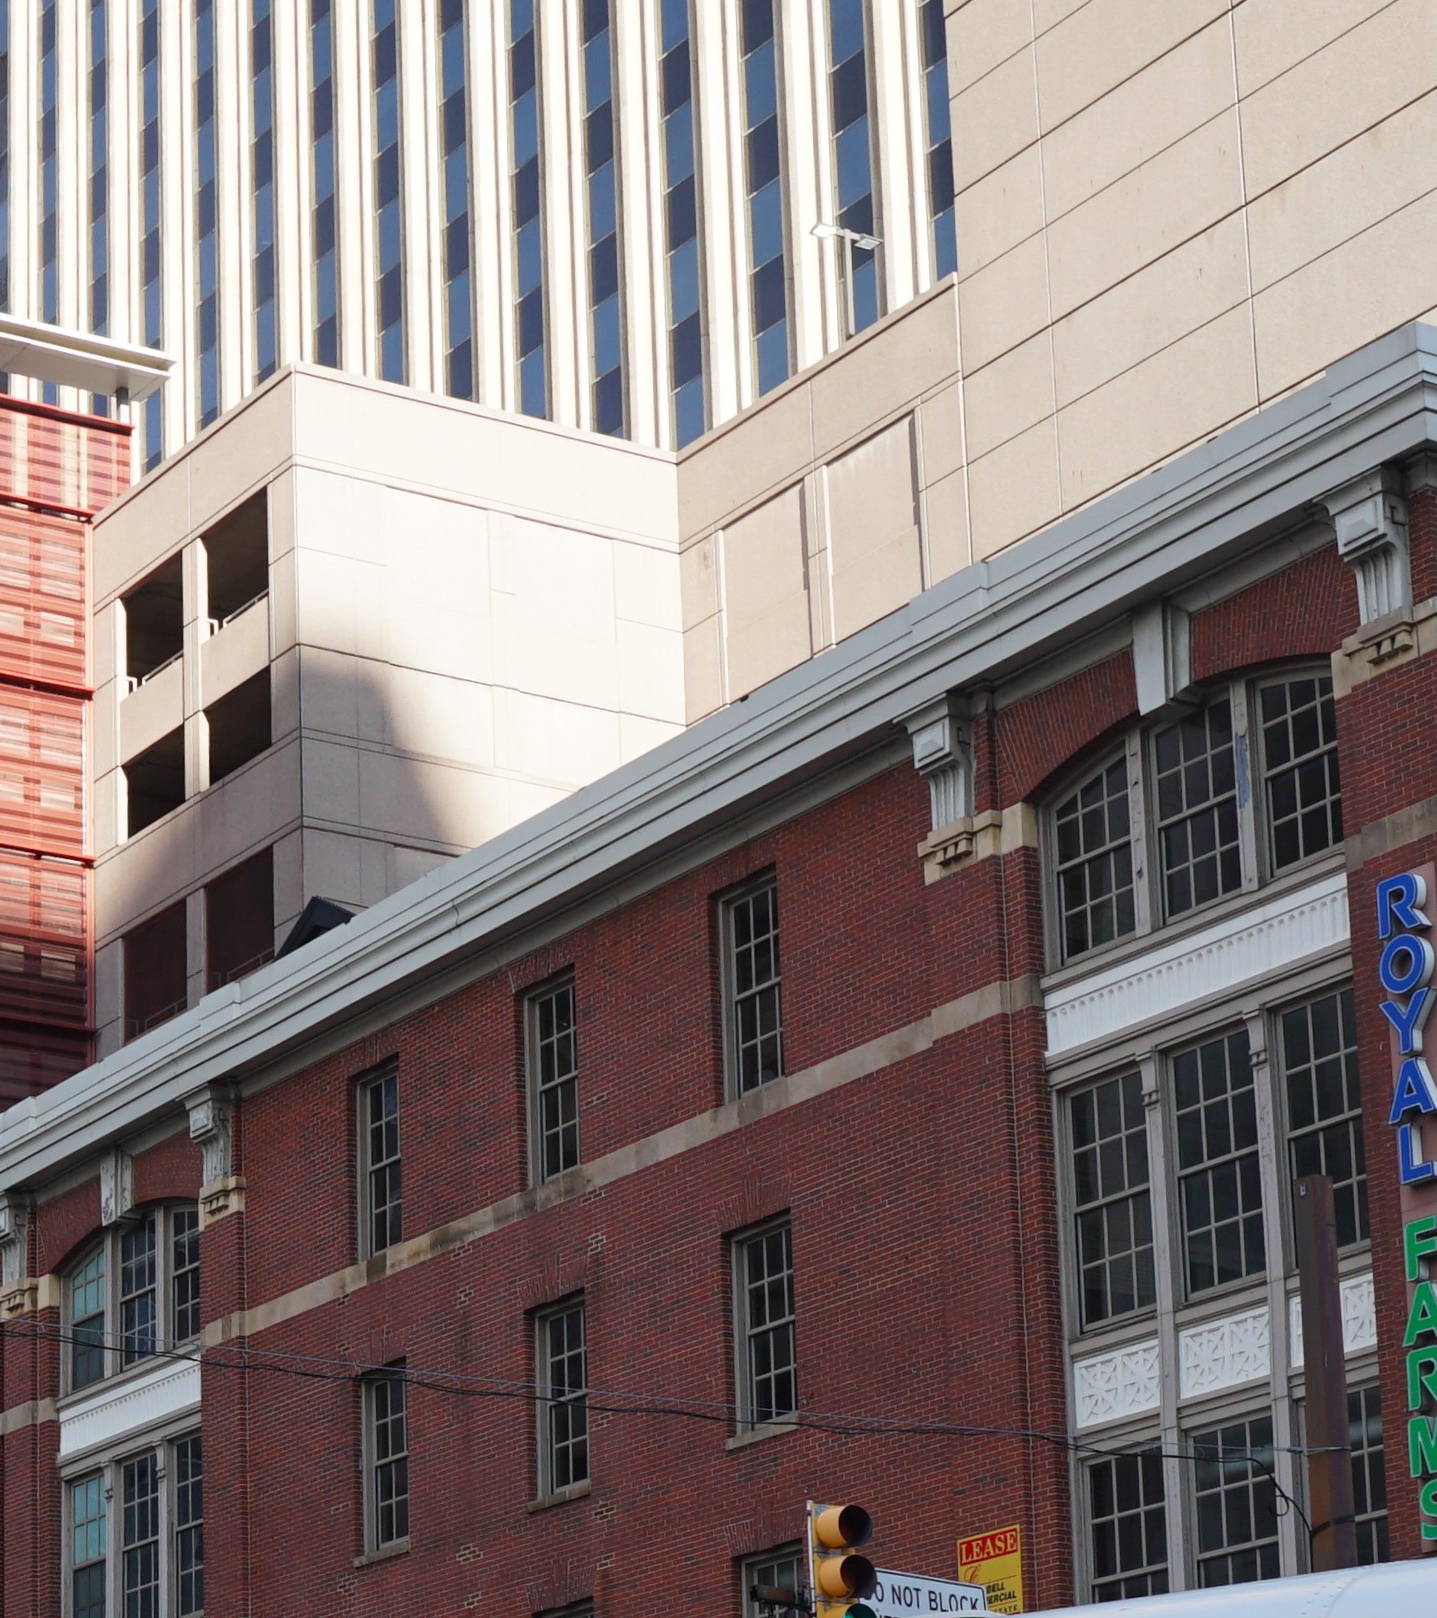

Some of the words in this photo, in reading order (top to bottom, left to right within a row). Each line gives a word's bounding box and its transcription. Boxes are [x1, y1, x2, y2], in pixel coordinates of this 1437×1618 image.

[960, 1531, 1017, 1564] LEASE
[891, 1584, 921, 1609] NOT
[928, 1590, 979, 1612] BLOCK
[986, 1582, 1005, 1594] BELL
[986, 1591, 1016, 1604] ERCIAL
